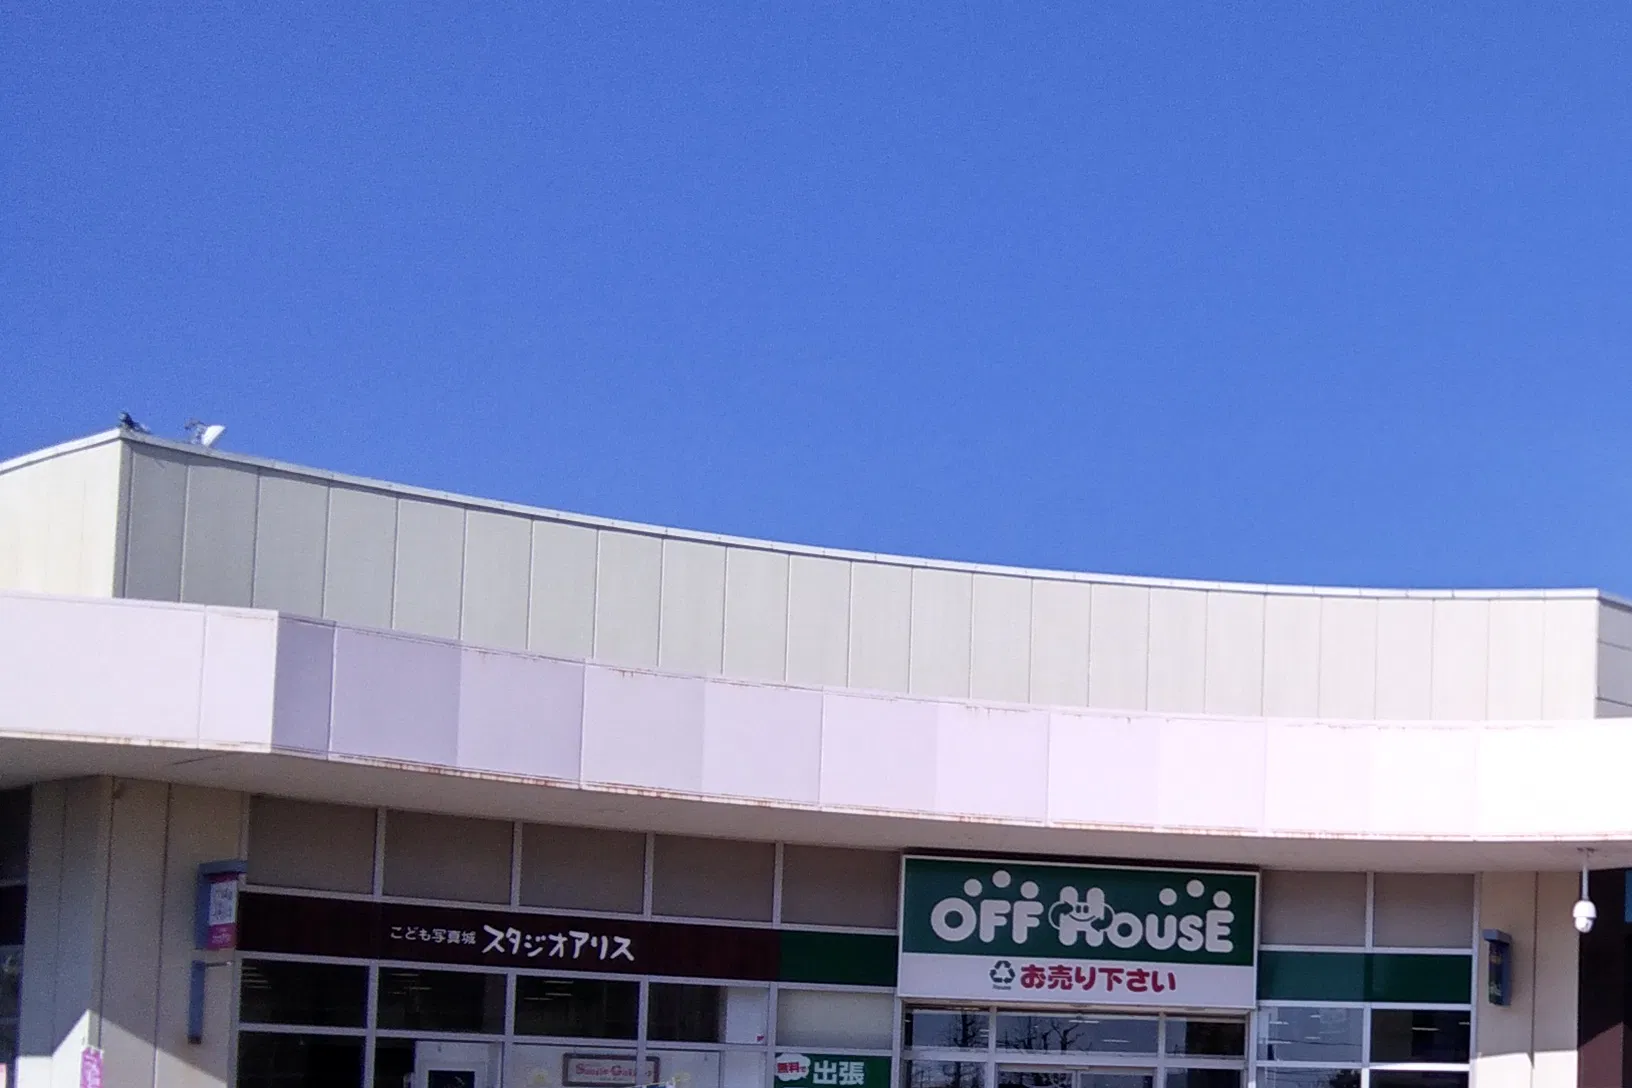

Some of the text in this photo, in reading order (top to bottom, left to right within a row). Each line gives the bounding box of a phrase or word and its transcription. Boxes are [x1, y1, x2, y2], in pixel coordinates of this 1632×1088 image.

[931, 886, 1235, 953] OFF HOUSE
[389, 924, 635, 962] こども写真城 スタジオアリス
[1020, 964, 1177, 993] お売り下さい
[812, 1060, 865, 1086] 出張
